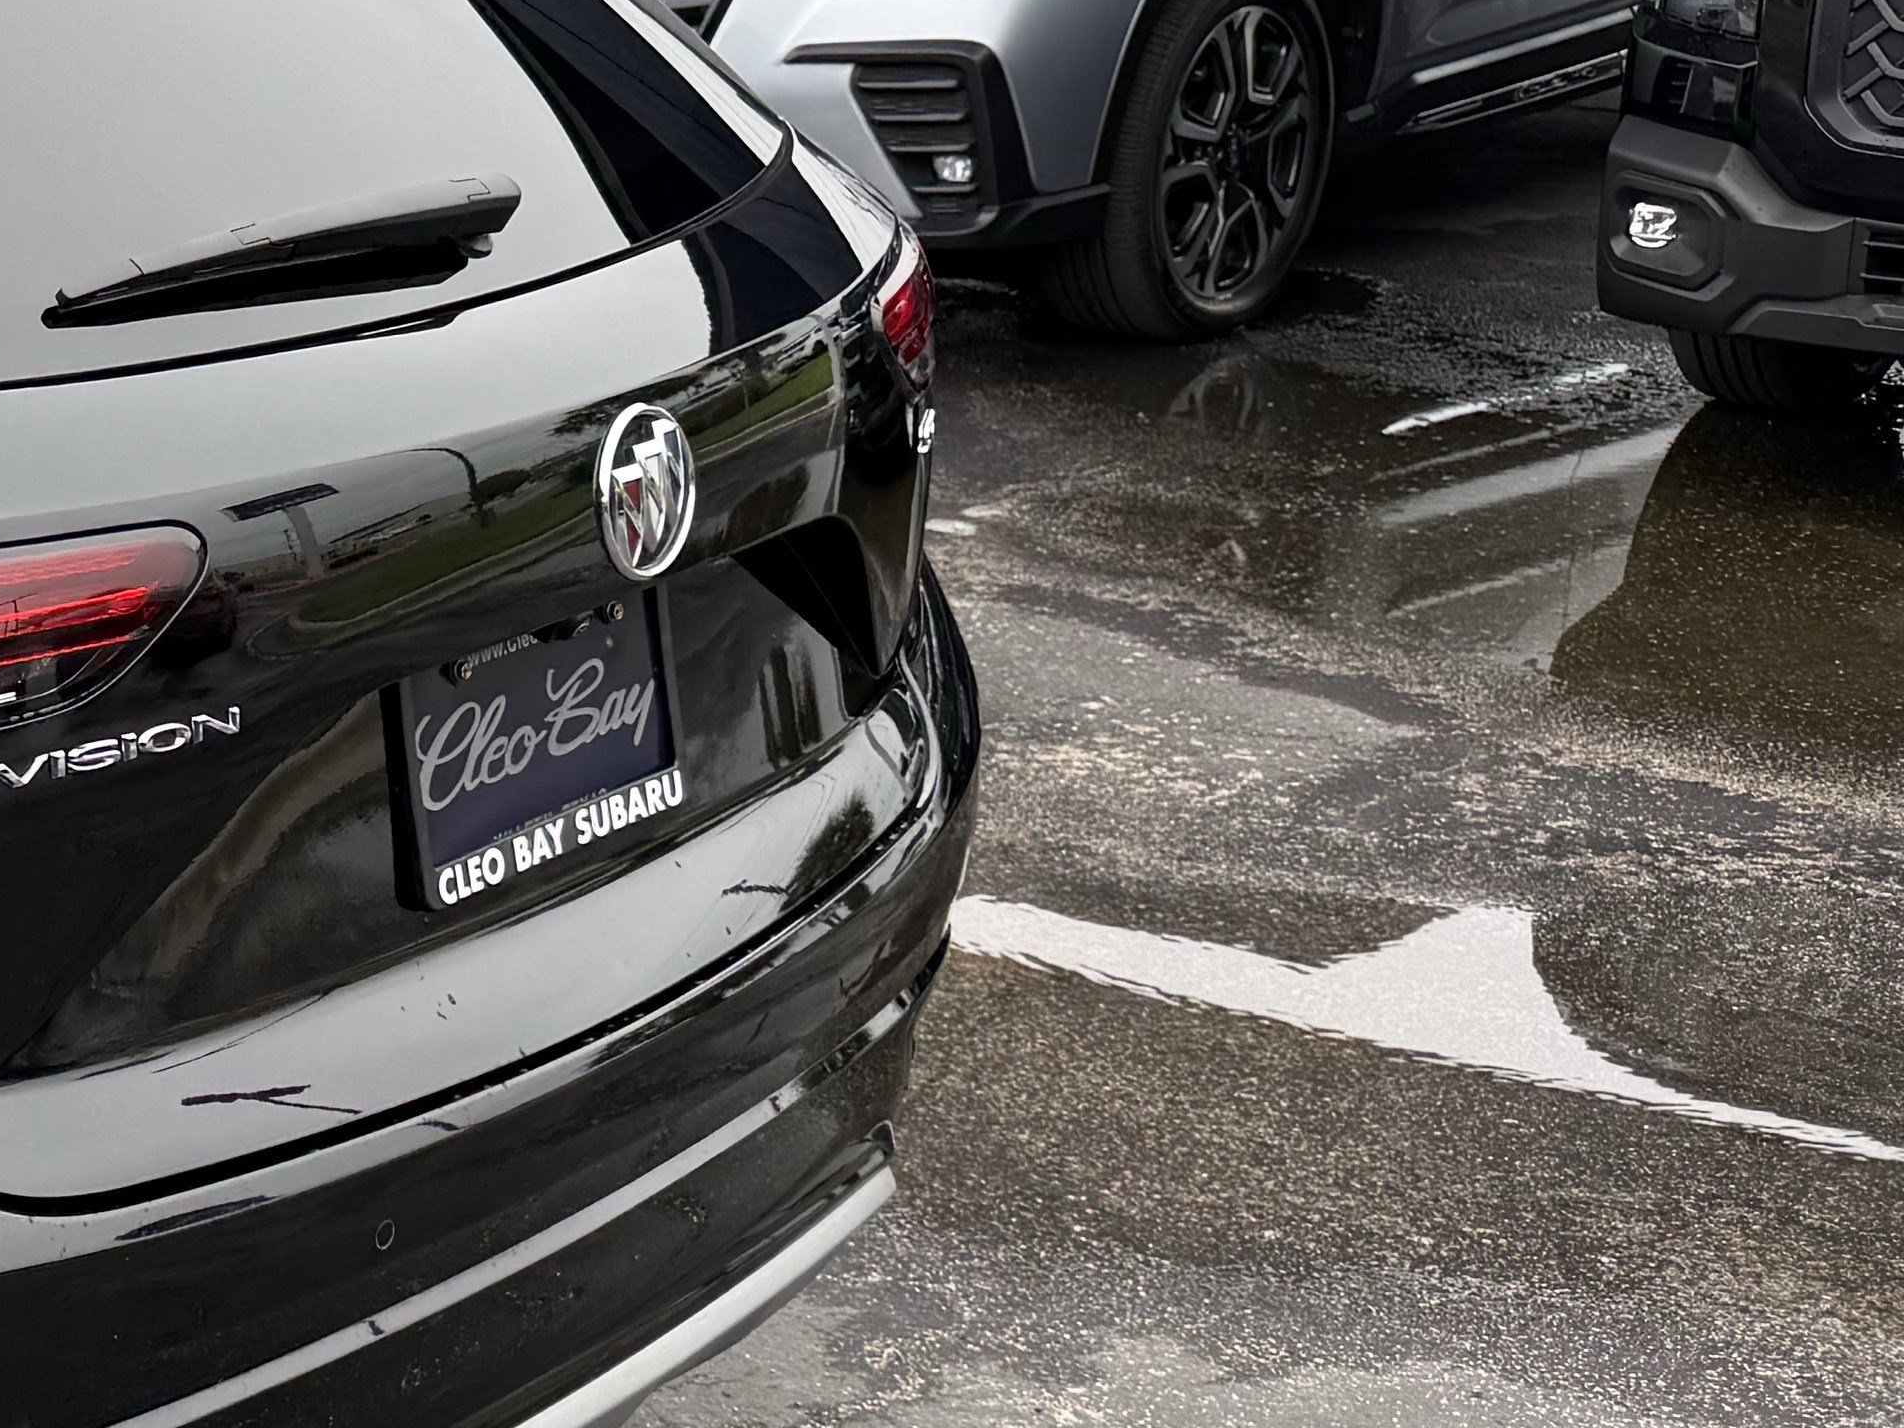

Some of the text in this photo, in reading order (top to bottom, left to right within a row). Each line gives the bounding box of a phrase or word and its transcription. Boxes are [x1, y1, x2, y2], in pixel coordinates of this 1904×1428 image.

[414, 657, 655, 812] Cleo Bay
[438, 847, 506, 905] CLEO
[512, 818, 565, 873] BAY
[574, 769, 684, 846] SUBARU
